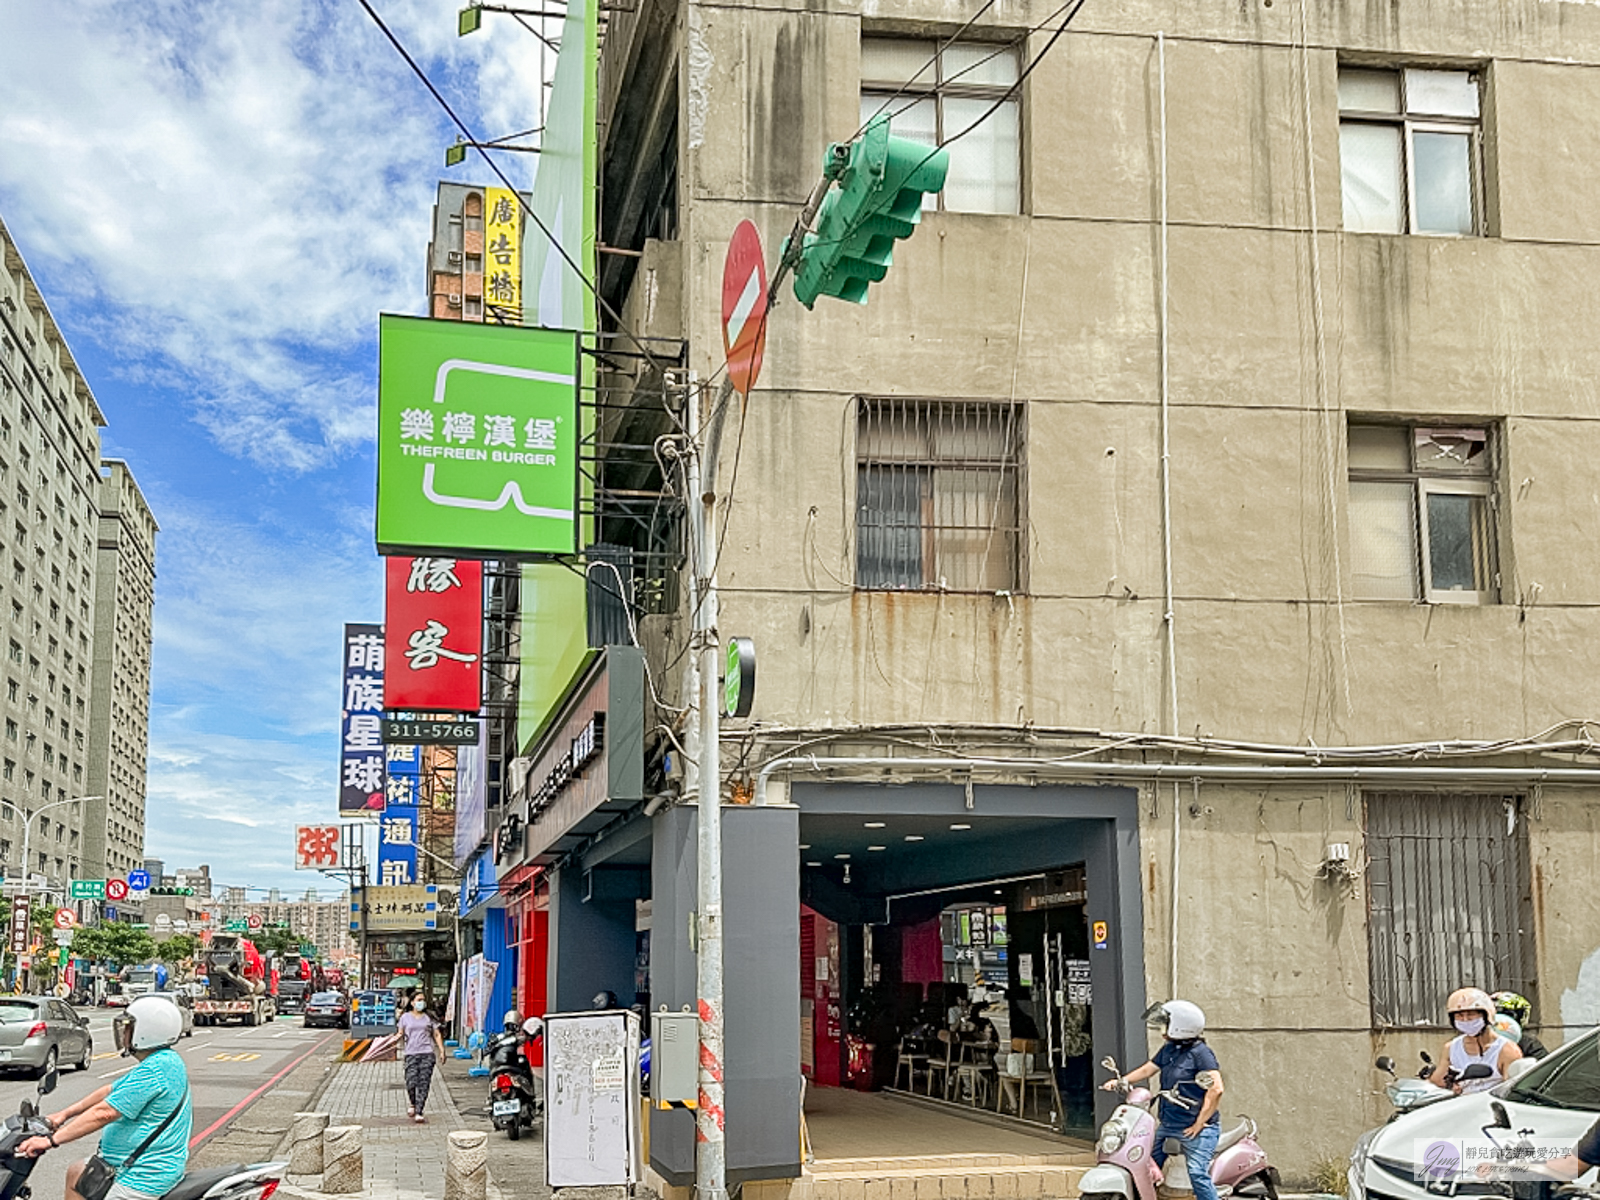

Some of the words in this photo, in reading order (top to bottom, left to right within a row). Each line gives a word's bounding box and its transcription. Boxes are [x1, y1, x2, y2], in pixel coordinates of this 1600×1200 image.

[400, 407, 556, 450] 樂檸漢堡
[400, 444, 487, 462] THEFREEN
[492, 450, 556, 466] BURGER
[343, 634, 385, 793] 萌族星球
[389, 724, 475, 738] 311-5766
[297, 827, 340, 866] 粥
